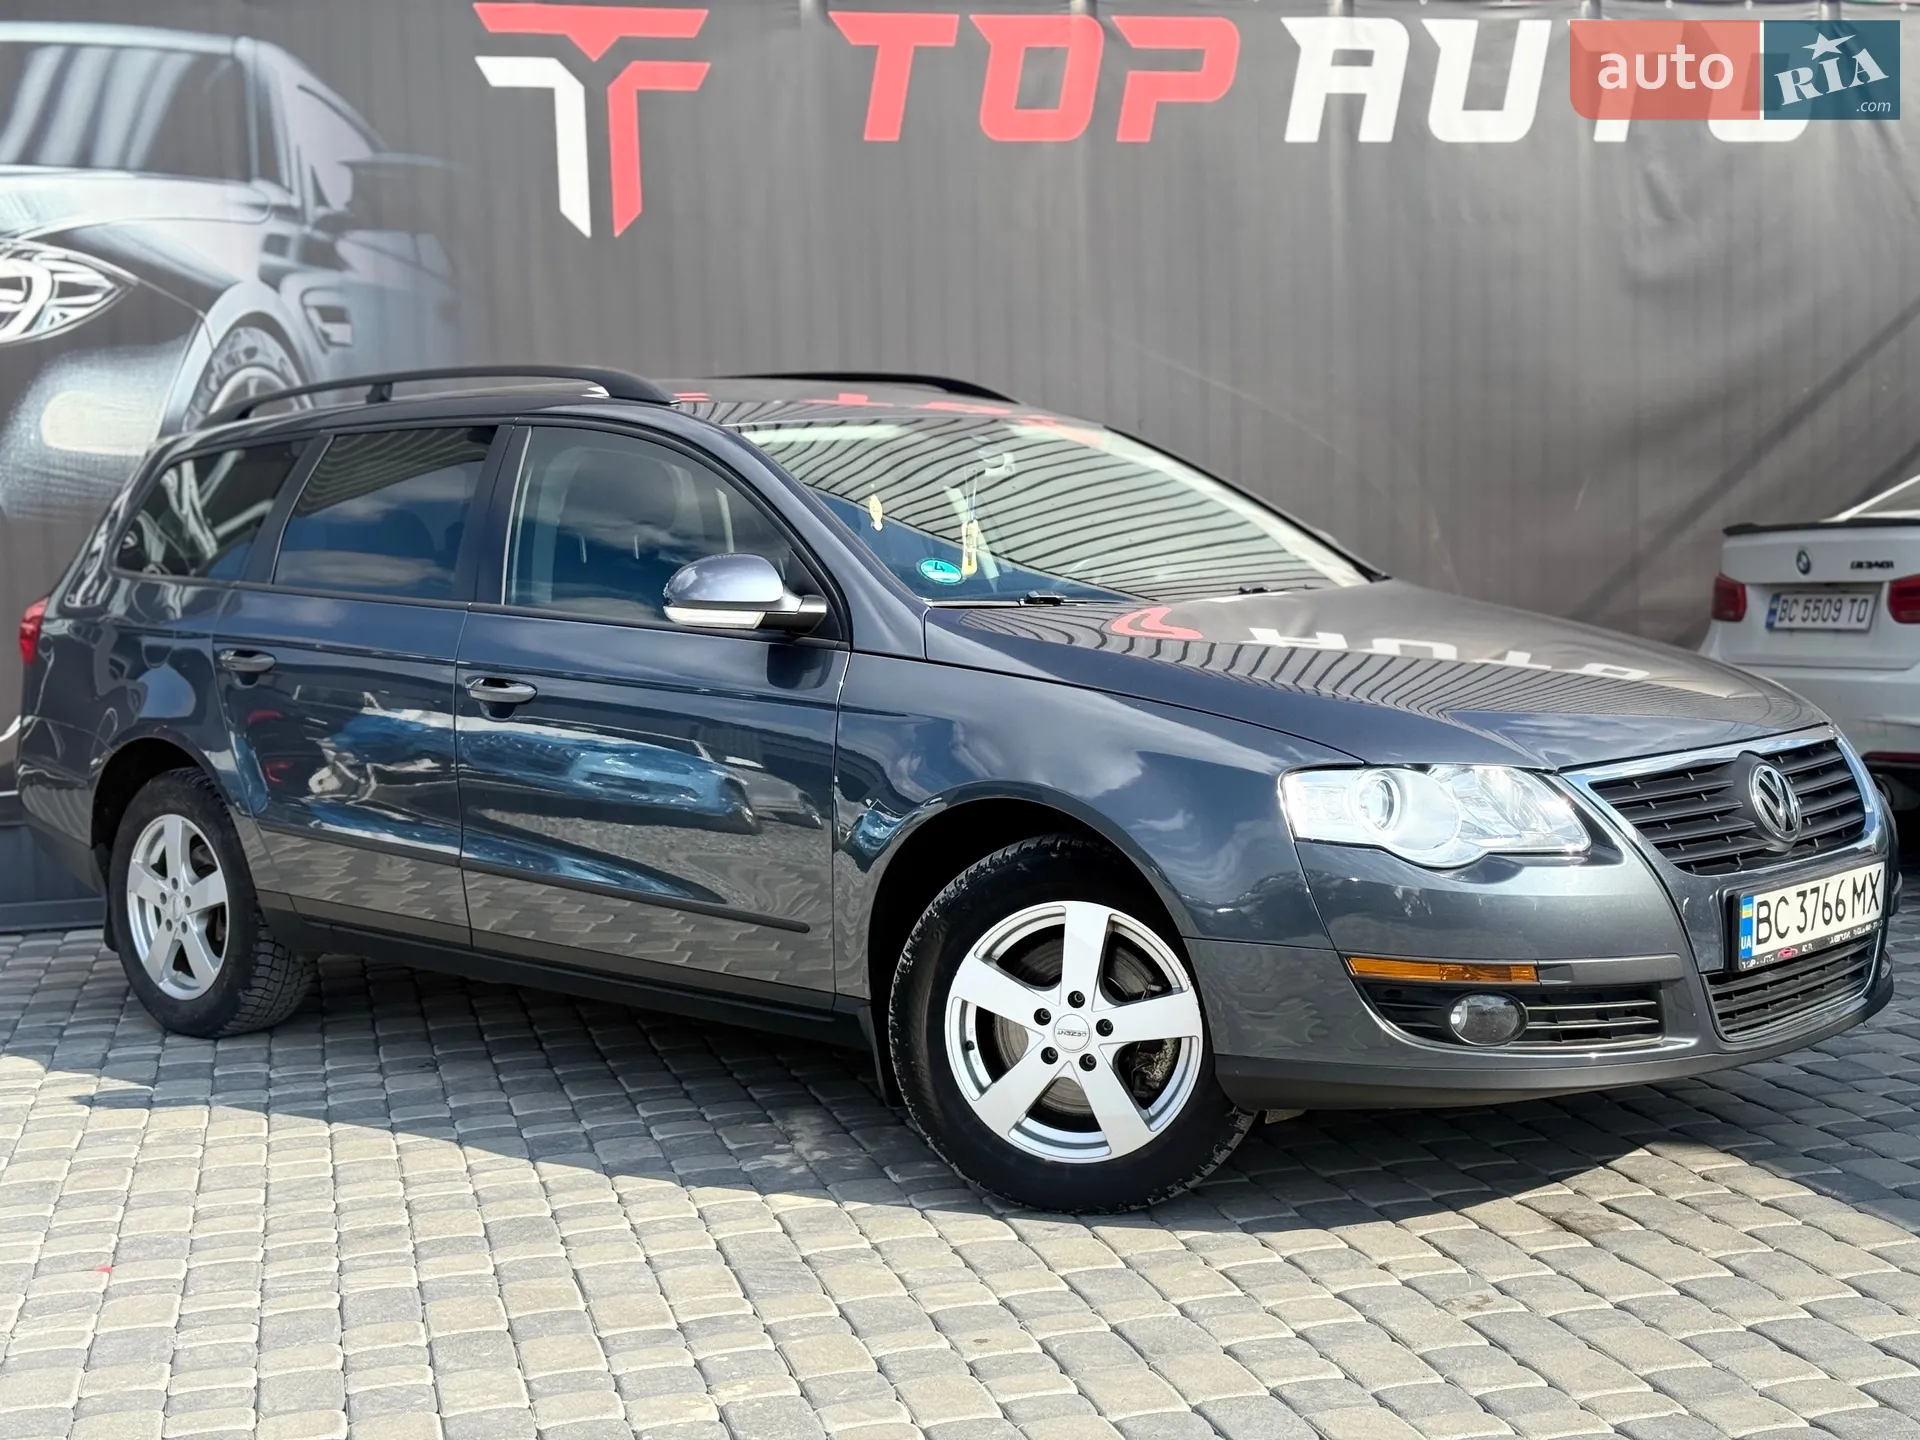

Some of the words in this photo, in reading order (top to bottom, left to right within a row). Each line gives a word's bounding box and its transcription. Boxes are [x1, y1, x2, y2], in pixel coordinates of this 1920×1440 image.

[829, 12, 1241, 142] TOP
[1778, 599, 1800, 622] BC
[1801, 599, 1842, 622] 5509
[1848, 599, 1869, 622] TO
[1756, 897, 1790, 945] BC
[1796, 879, 1846, 933] 3766
[1852, 869, 1881, 918] MX
[1741, 936, 1752, 949] UA
